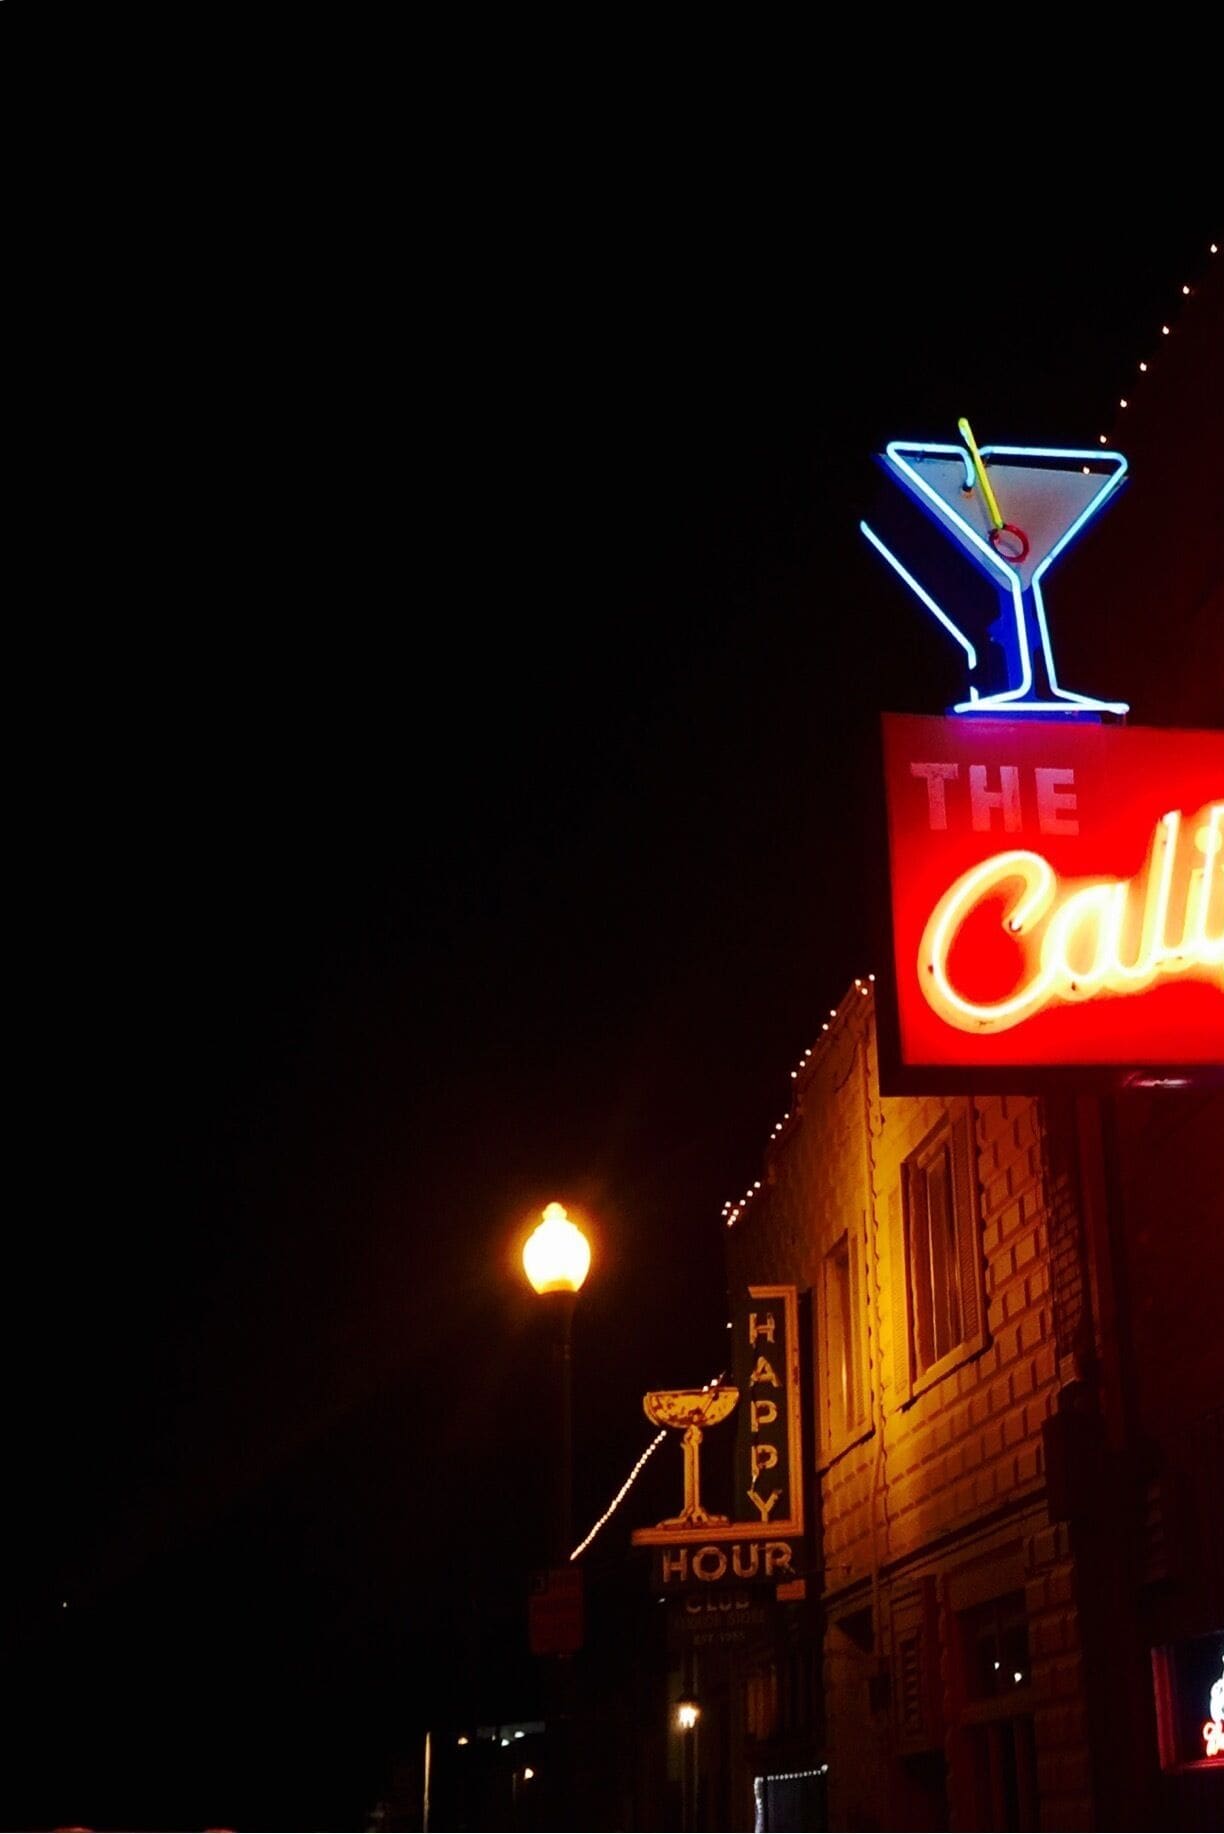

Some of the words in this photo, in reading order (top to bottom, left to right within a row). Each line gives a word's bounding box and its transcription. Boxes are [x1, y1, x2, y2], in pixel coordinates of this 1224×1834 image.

[910, 762, 1080, 837] THE
[747, 1311, 783, 1523] HAPPY
[661, 1541, 796, 1584] HOUR
[685, 1591, 751, 1614] CLUB
